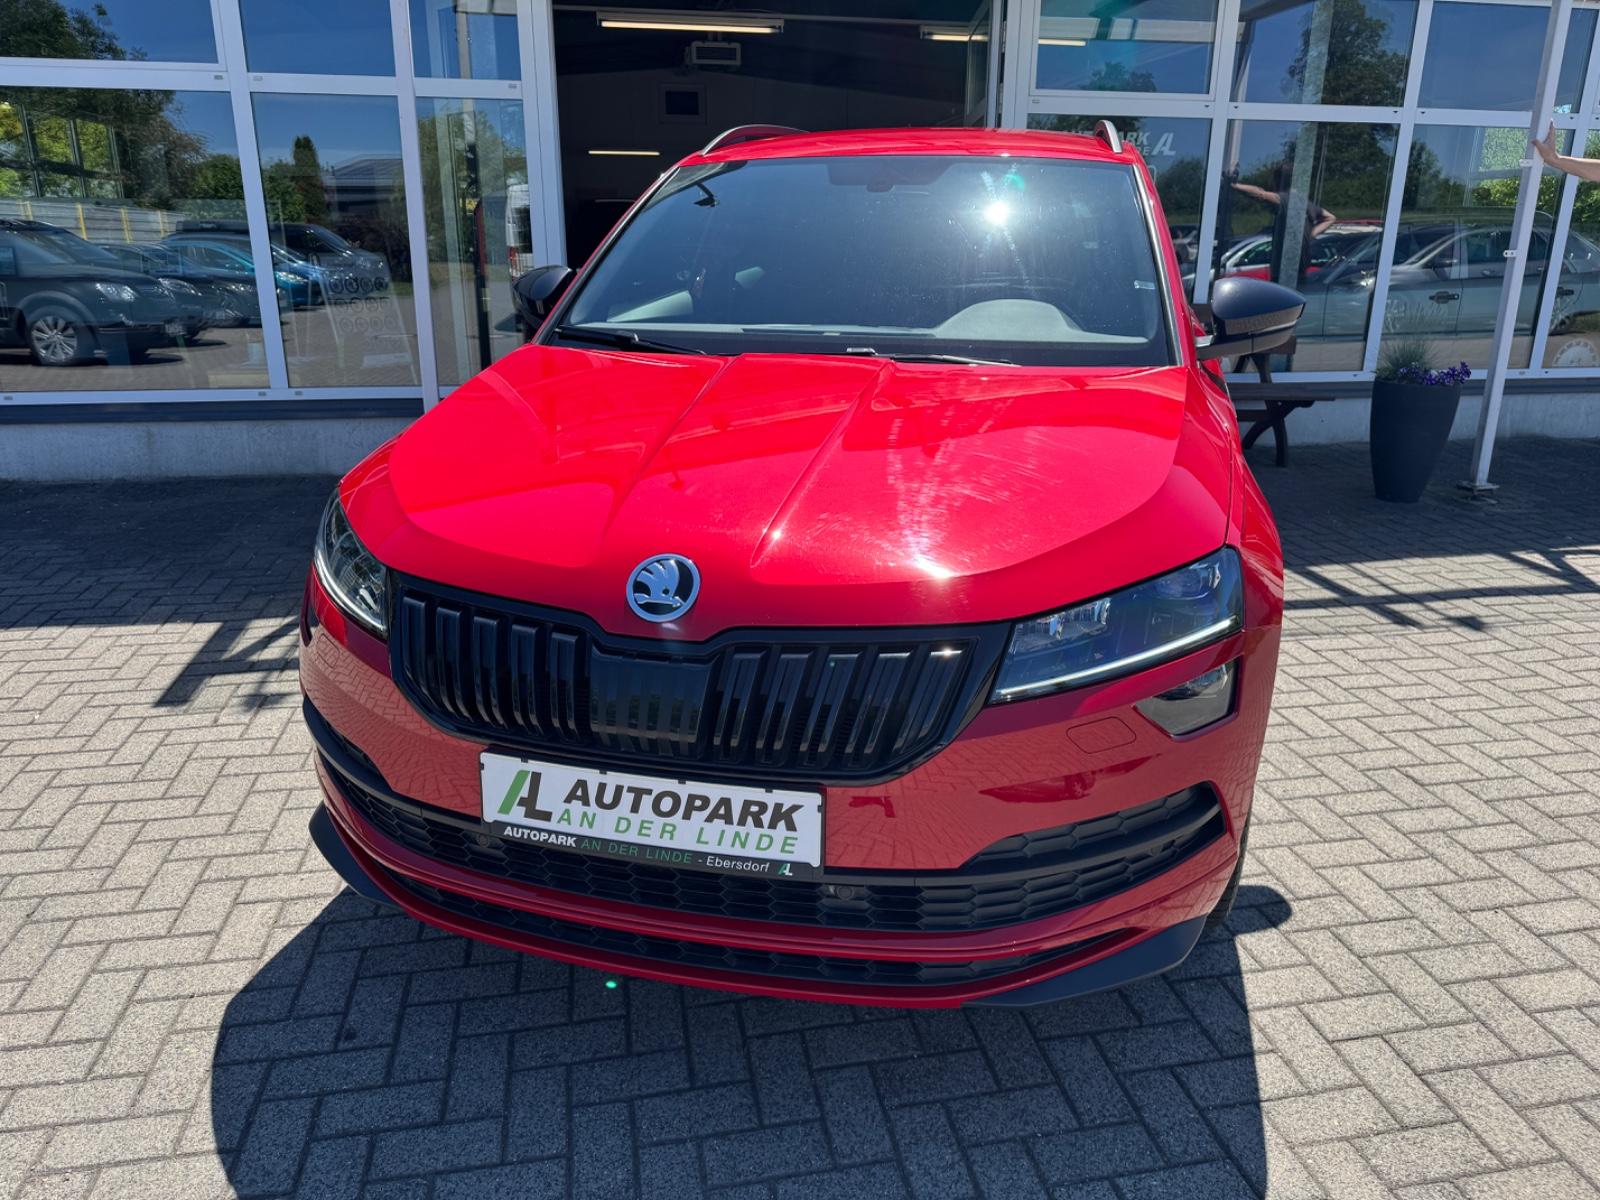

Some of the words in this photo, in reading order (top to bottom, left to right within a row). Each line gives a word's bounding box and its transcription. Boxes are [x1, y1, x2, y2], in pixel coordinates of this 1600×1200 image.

[497, 769, 553, 822] AL
[563, 778, 804, 832] AUTOPARK
[504, 826, 577, 847] AUTOPARK
[581, 839, 601, 851] AN
[608, 842, 638, 857] DER
[646, 848, 694, 863] LINDE
[706, 856, 770, 873] Ebersdorf
[557, 808, 597, 829] AN
[614, 816, 677, 841] DER
[696, 827, 798, 854] LINDE
